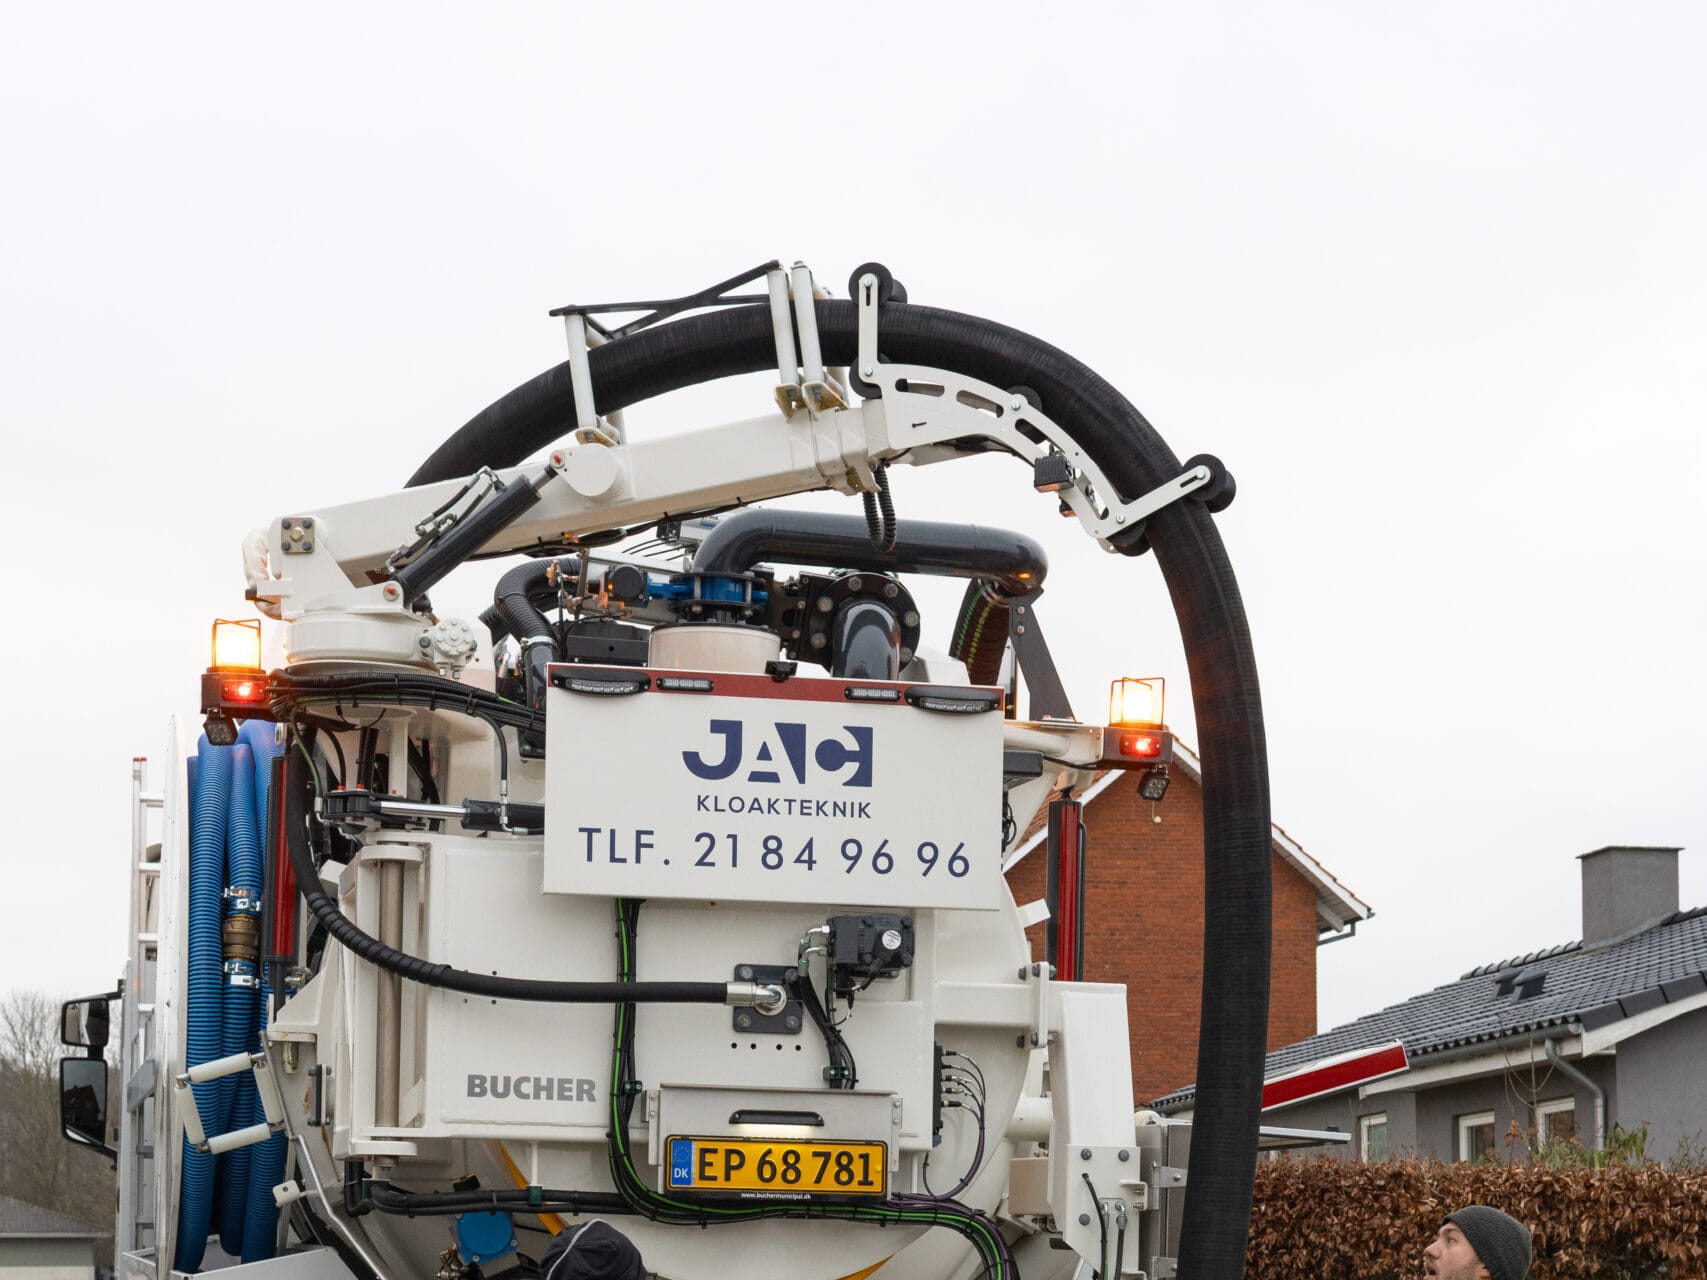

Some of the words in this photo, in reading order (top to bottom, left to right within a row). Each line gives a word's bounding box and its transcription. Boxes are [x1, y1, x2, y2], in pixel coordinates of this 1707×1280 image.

[697, 795, 871, 818] KLOAKTEKNIK
[579, 827, 670, 865] TLF.
[694, 832, 738, 868] 21
[761, 835, 817, 870] 84
[840, 838, 894, 874] 96
[917, 841, 970, 878] 96
[467, 1074, 597, 1102] BUCHER
[674, 1167, 688, 1179] DK
[699, 1147, 746, 1182] EP
[757, 1148, 801, 1184] 68
[812, 1150, 874, 1186] 781
[741, 1191, 812, 1200] www.buchermunicipal.dk
